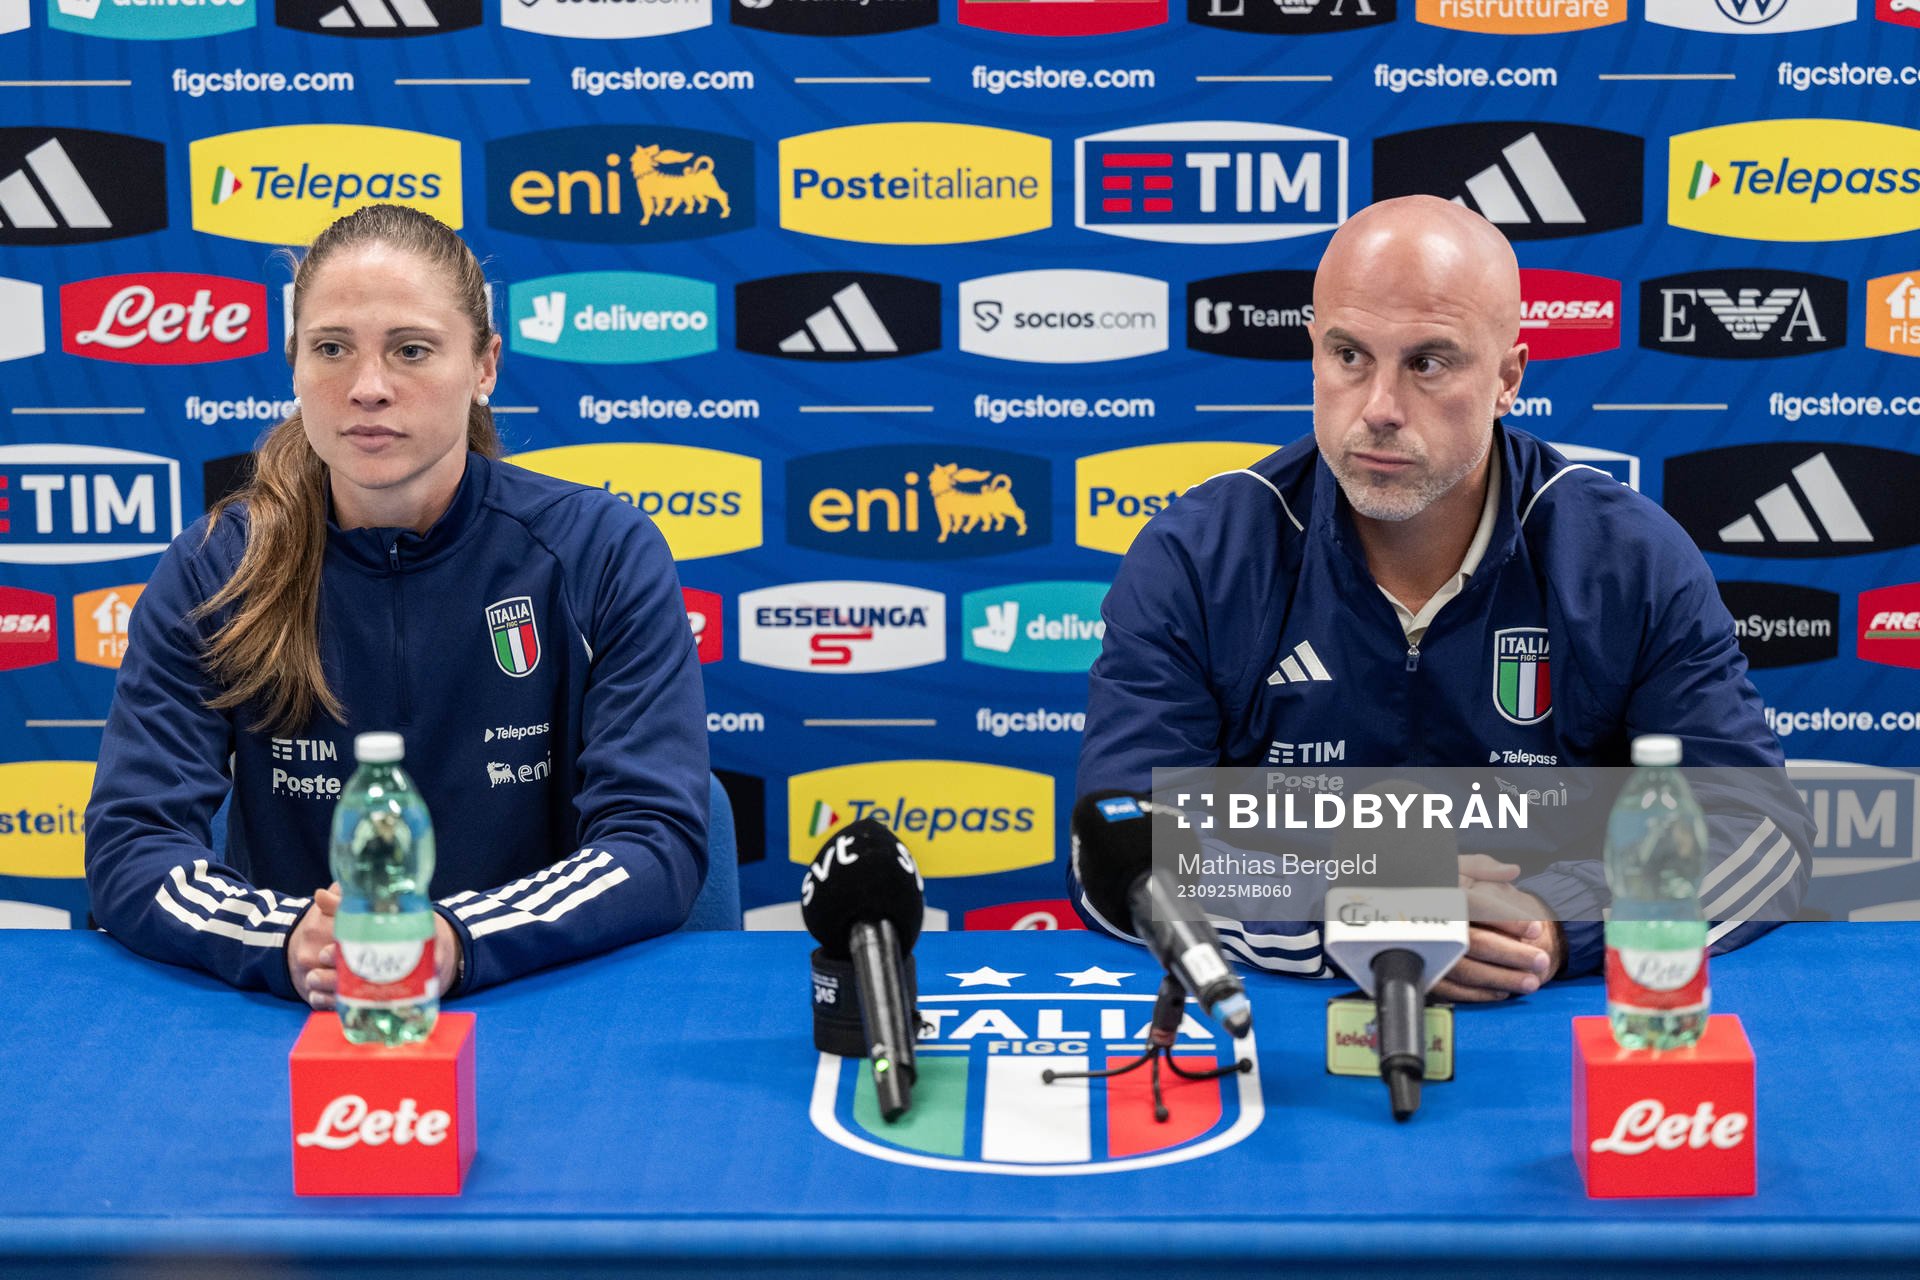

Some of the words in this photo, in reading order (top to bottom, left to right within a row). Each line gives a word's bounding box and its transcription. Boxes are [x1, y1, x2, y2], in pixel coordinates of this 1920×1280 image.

[172, 68, 354, 97] figcstore.com
[571, 66, 754, 95] figcstore.com
[972, 65, 1155, 94] figcstore.com
[1374, 63, 1557, 93] figcstore.com
[1777, 61, 1920, 91] figcstore.c
[250, 163, 441, 207] Telepass
[510, 154, 622, 216] eni
[792, 167, 1039, 201] Posteitaliane
[1186, 152, 1322, 213] TIM
[1728, 157, 1920, 204] Telepass
[75, 285, 250, 348] Lete
[574, 303, 708, 332] deliveroo
[1238, 304, 1315, 328] TeamS
[1889, 321, 1920, 345] ris
[185, 396, 297, 426] figcstore
[579, 395, 760, 424] figcstore.com
[974, 394, 1156, 423] figcstore.com
[1769, 392, 1920, 422] figcstore.co
[20, 474, 156, 534] TIM
[809, 472, 919, 533] eni
[1089, 486, 1178, 518] Post
[0, 614, 51, 633] SSA
[490, 602, 530, 626] ITALIA
[755, 607, 927, 627] ESSELUNGA
[1025, 613, 1106, 640] delive
[1869, 611, 1920, 630] FRE
[1520, 654, 1537, 662] FIGC
[495, 722, 550, 741] Telepass
[976, 707, 1087, 737] figcstore
[296, 739, 338, 761] TIM
[1298, 740, 1346, 763] TIM
[1502, 749, 1558, 766] Telepass
[272, 767, 341, 794] Poste
[1266, 772, 1344, 791] Poste
[1526, 781, 1567, 806] eni
[848, 797, 1034, 841] Telepass
[917, 1009, 1214, 1039] TALIA
[988, 1041, 1089, 1054] FIGC
[296, 1094, 451, 1150] Lete
[1591, 1099, 1748, 1155] Lete
